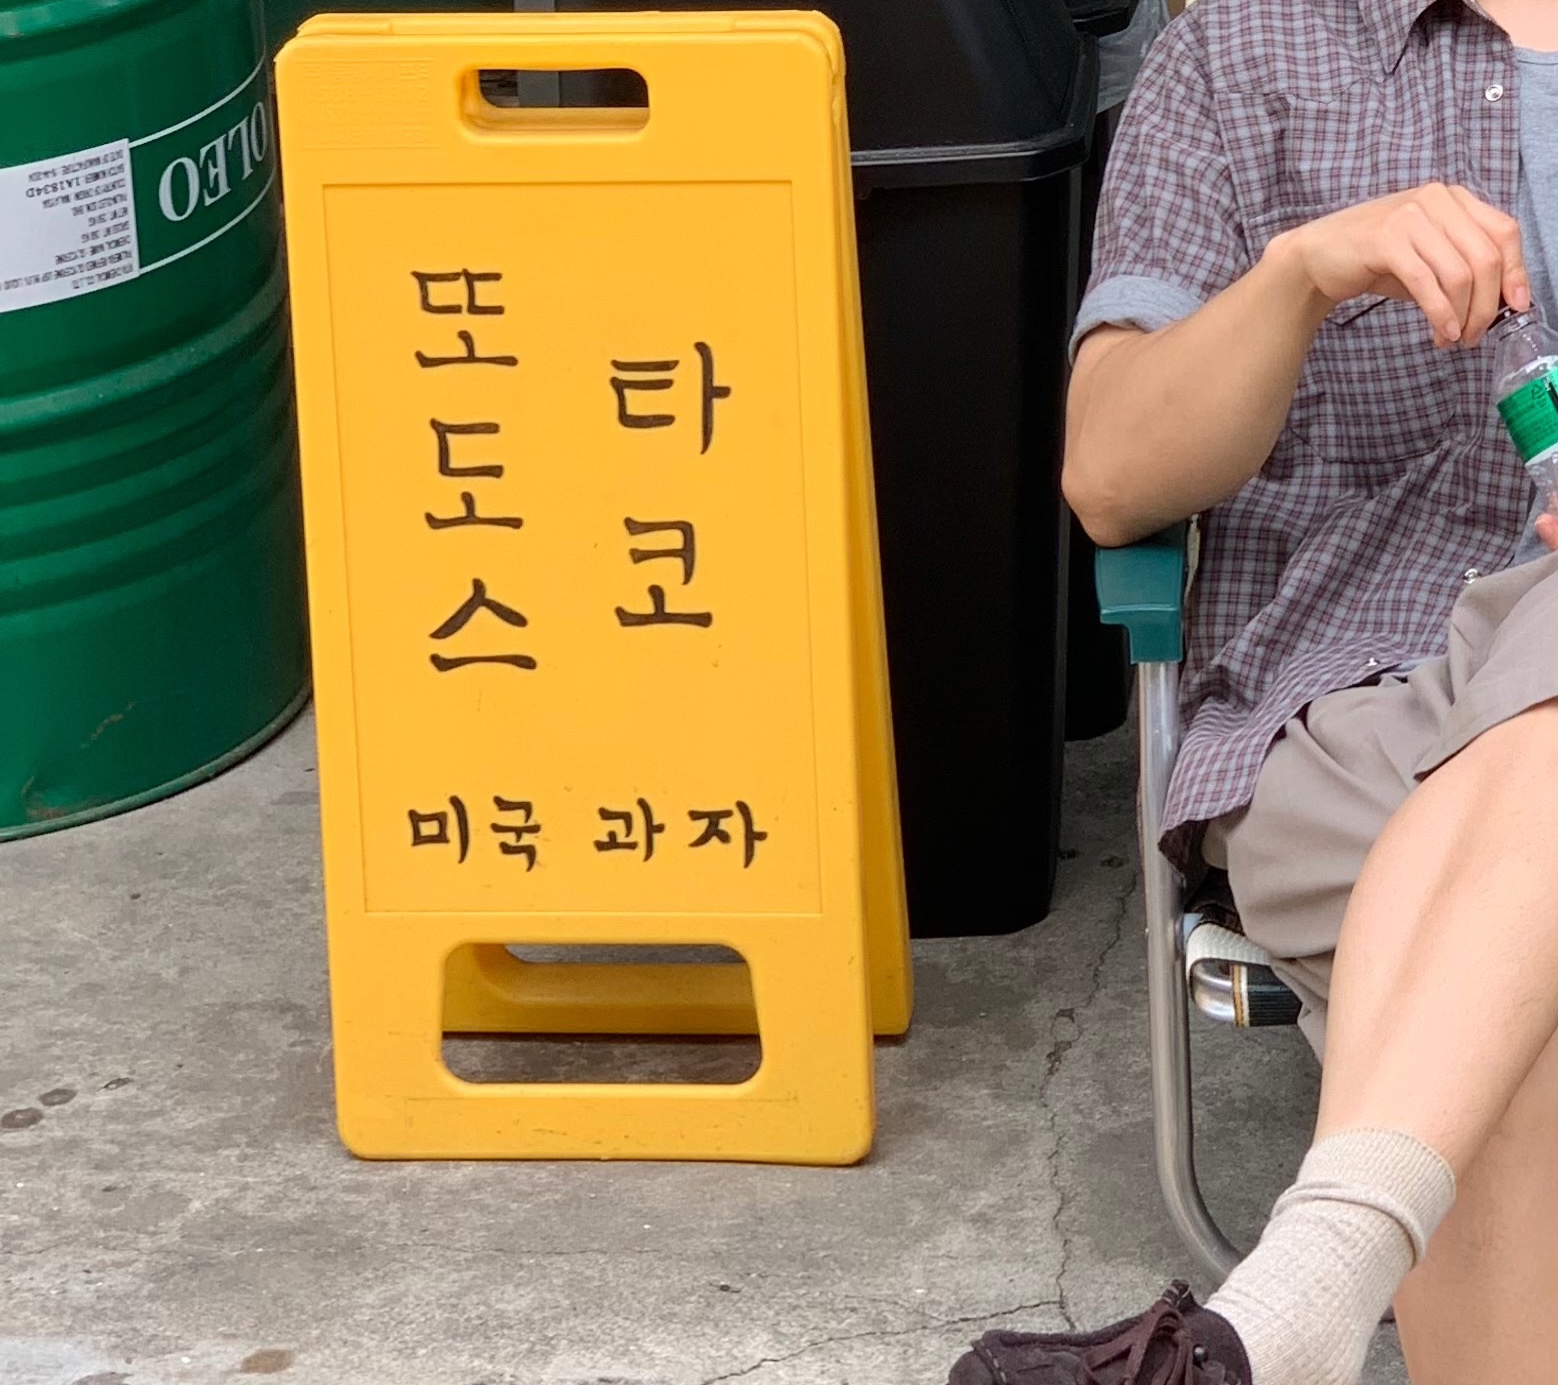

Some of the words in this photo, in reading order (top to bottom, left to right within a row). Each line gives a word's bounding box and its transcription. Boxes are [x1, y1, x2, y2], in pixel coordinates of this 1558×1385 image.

[159, 101, 268, 222] OLEO
[411, 268, 538, 672] 또도스
[610, 341, 732, 629] 타코
[408, 795, 542, 872] 미국
[594, 798, 768, 869] 과자
